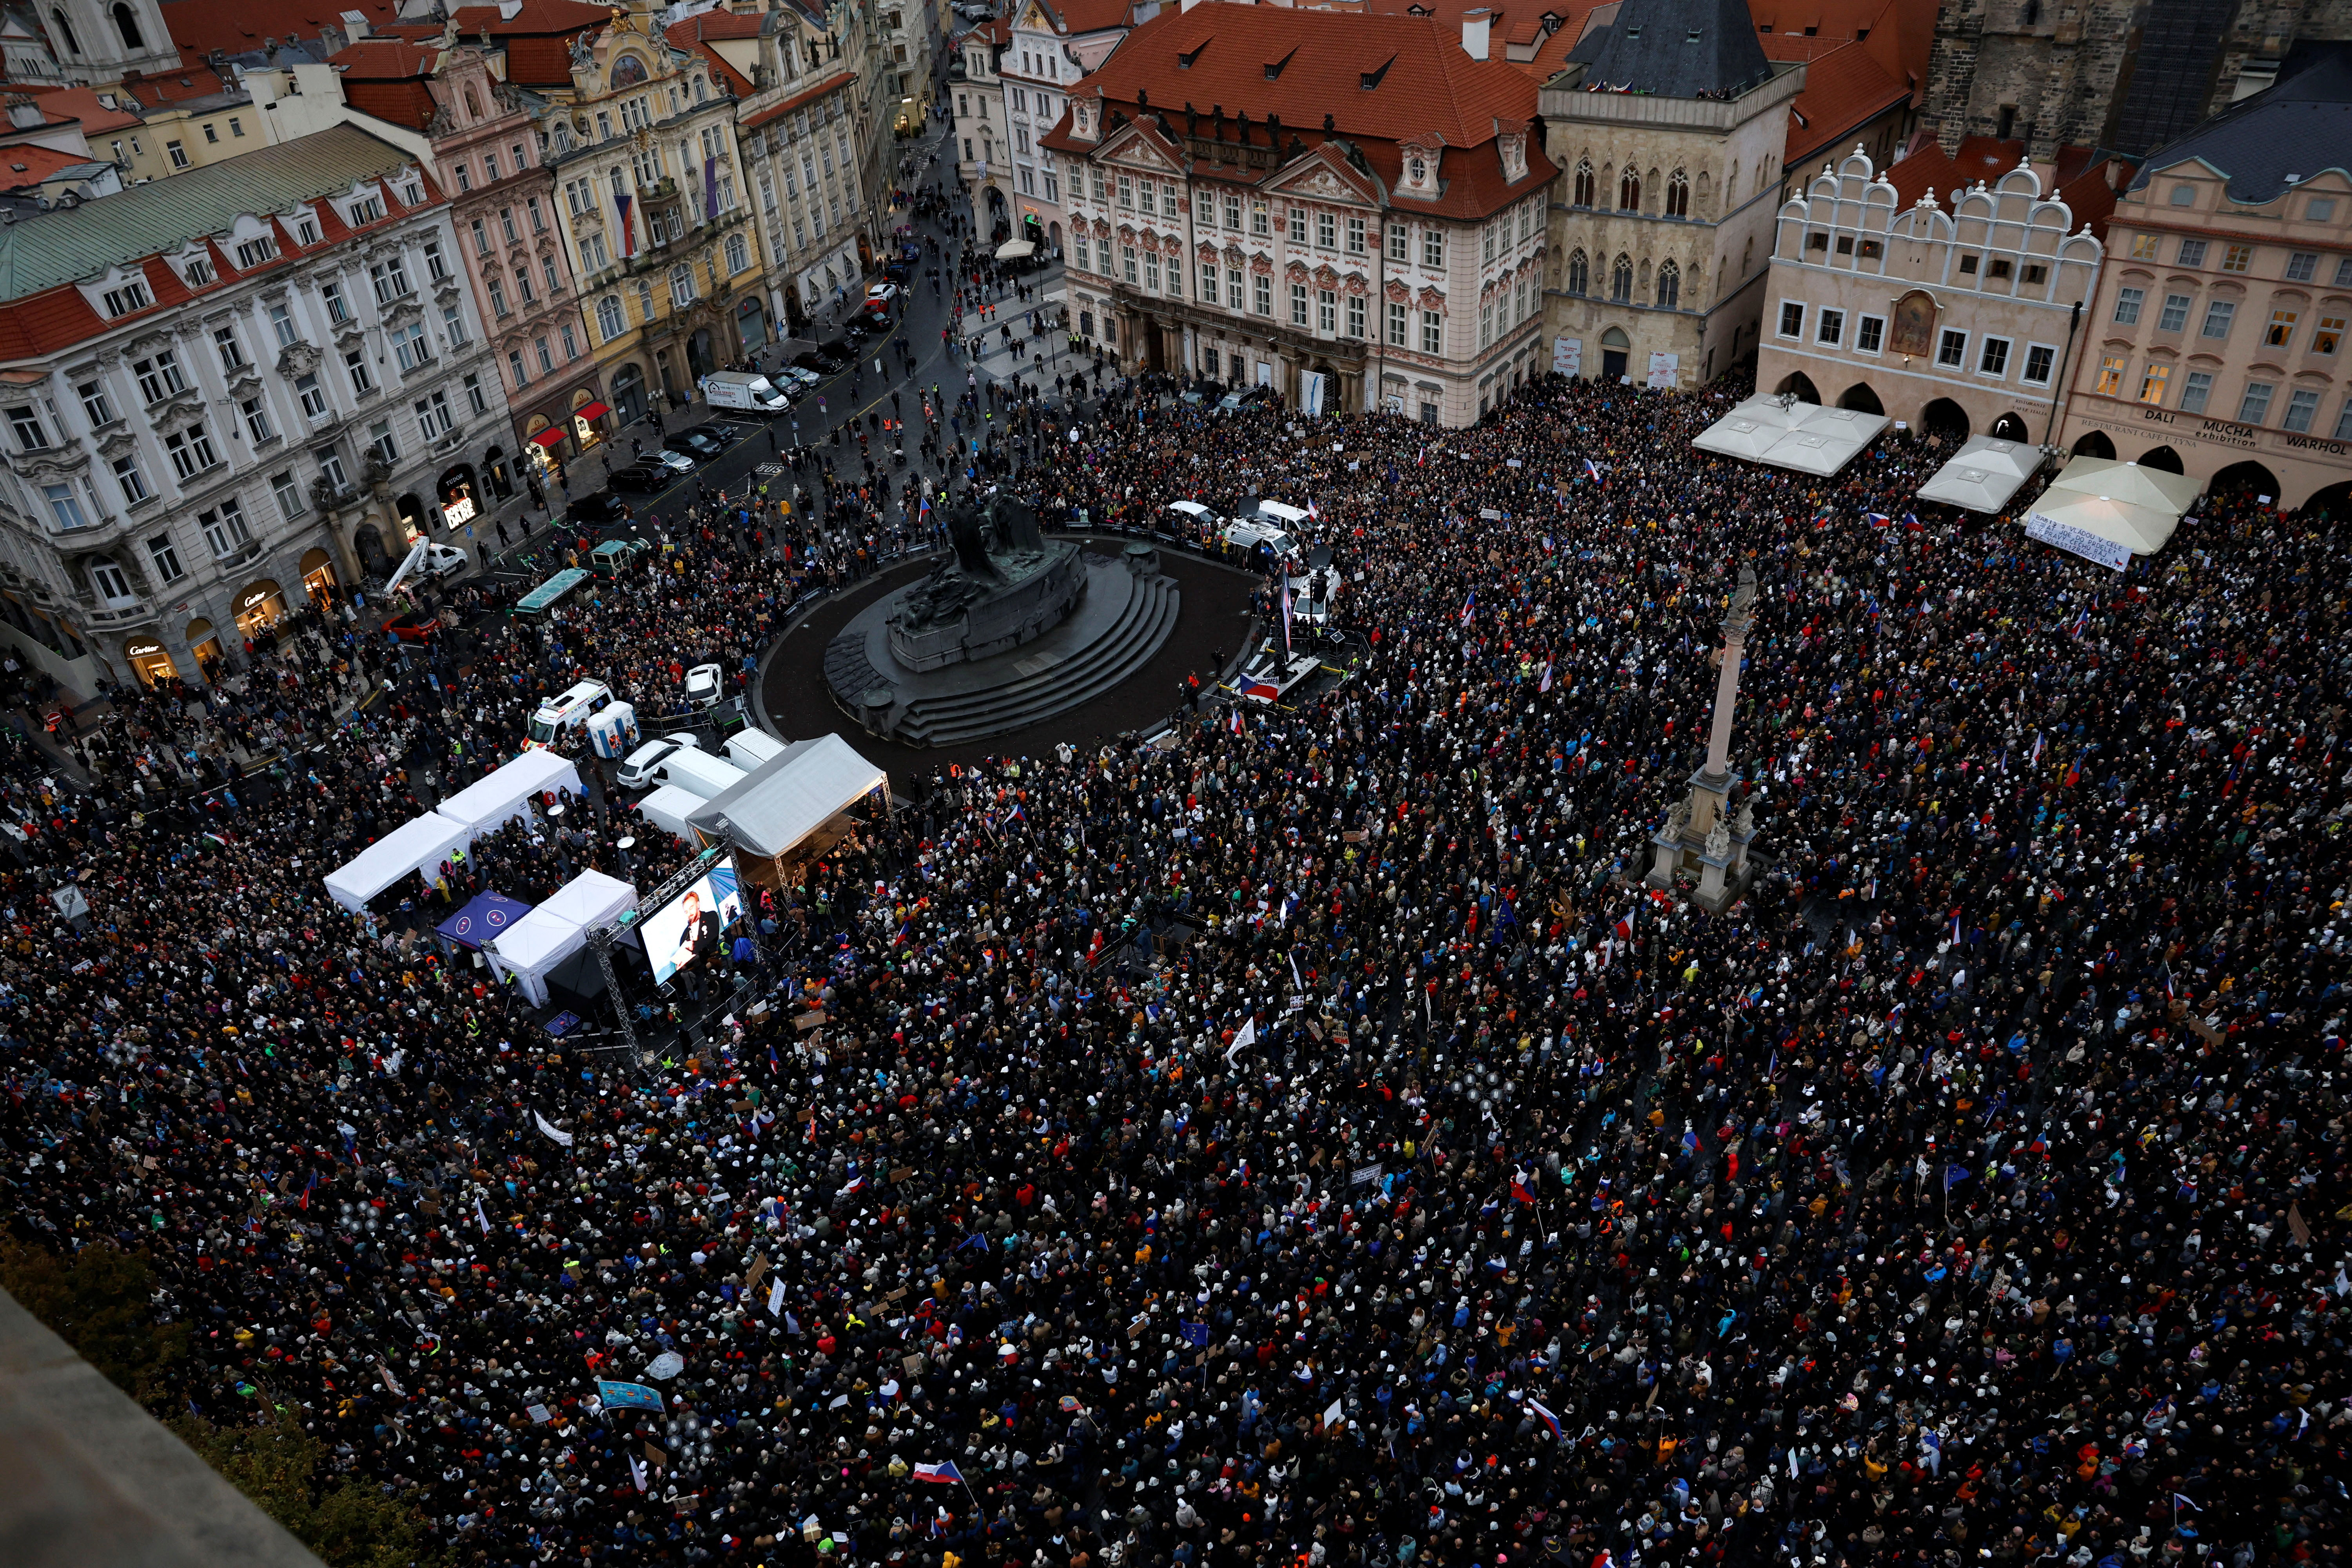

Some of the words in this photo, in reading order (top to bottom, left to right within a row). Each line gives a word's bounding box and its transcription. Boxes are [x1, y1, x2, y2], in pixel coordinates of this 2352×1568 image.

[576, 396, 589, 407] OMEGA
[2016, 399, 2045, 408] RISTORANTE
[2145, 410, 2175, 424] DALÍ
[531, 422, 546, 433] OMEGA
[2082, 419, 2138, 436] RESTAURANT
[2203, 420, 2252, 438] MUCHA
[2195, 431, 2256, 447] exhibition
[2286, 436, 2346, 455] WARHOL
[446, 473, 464, 486] TUDOR
[446, 507, 475, 530] DARE
[2031, 531, 2042, 539] BEZ
[2088, 540, 2116, 555] PRDELE!
[245, 592, 266, 607] Cartier
[130, 646, 159, 655] Cartier
[571, 693, 600, 714] AMBULANCE
